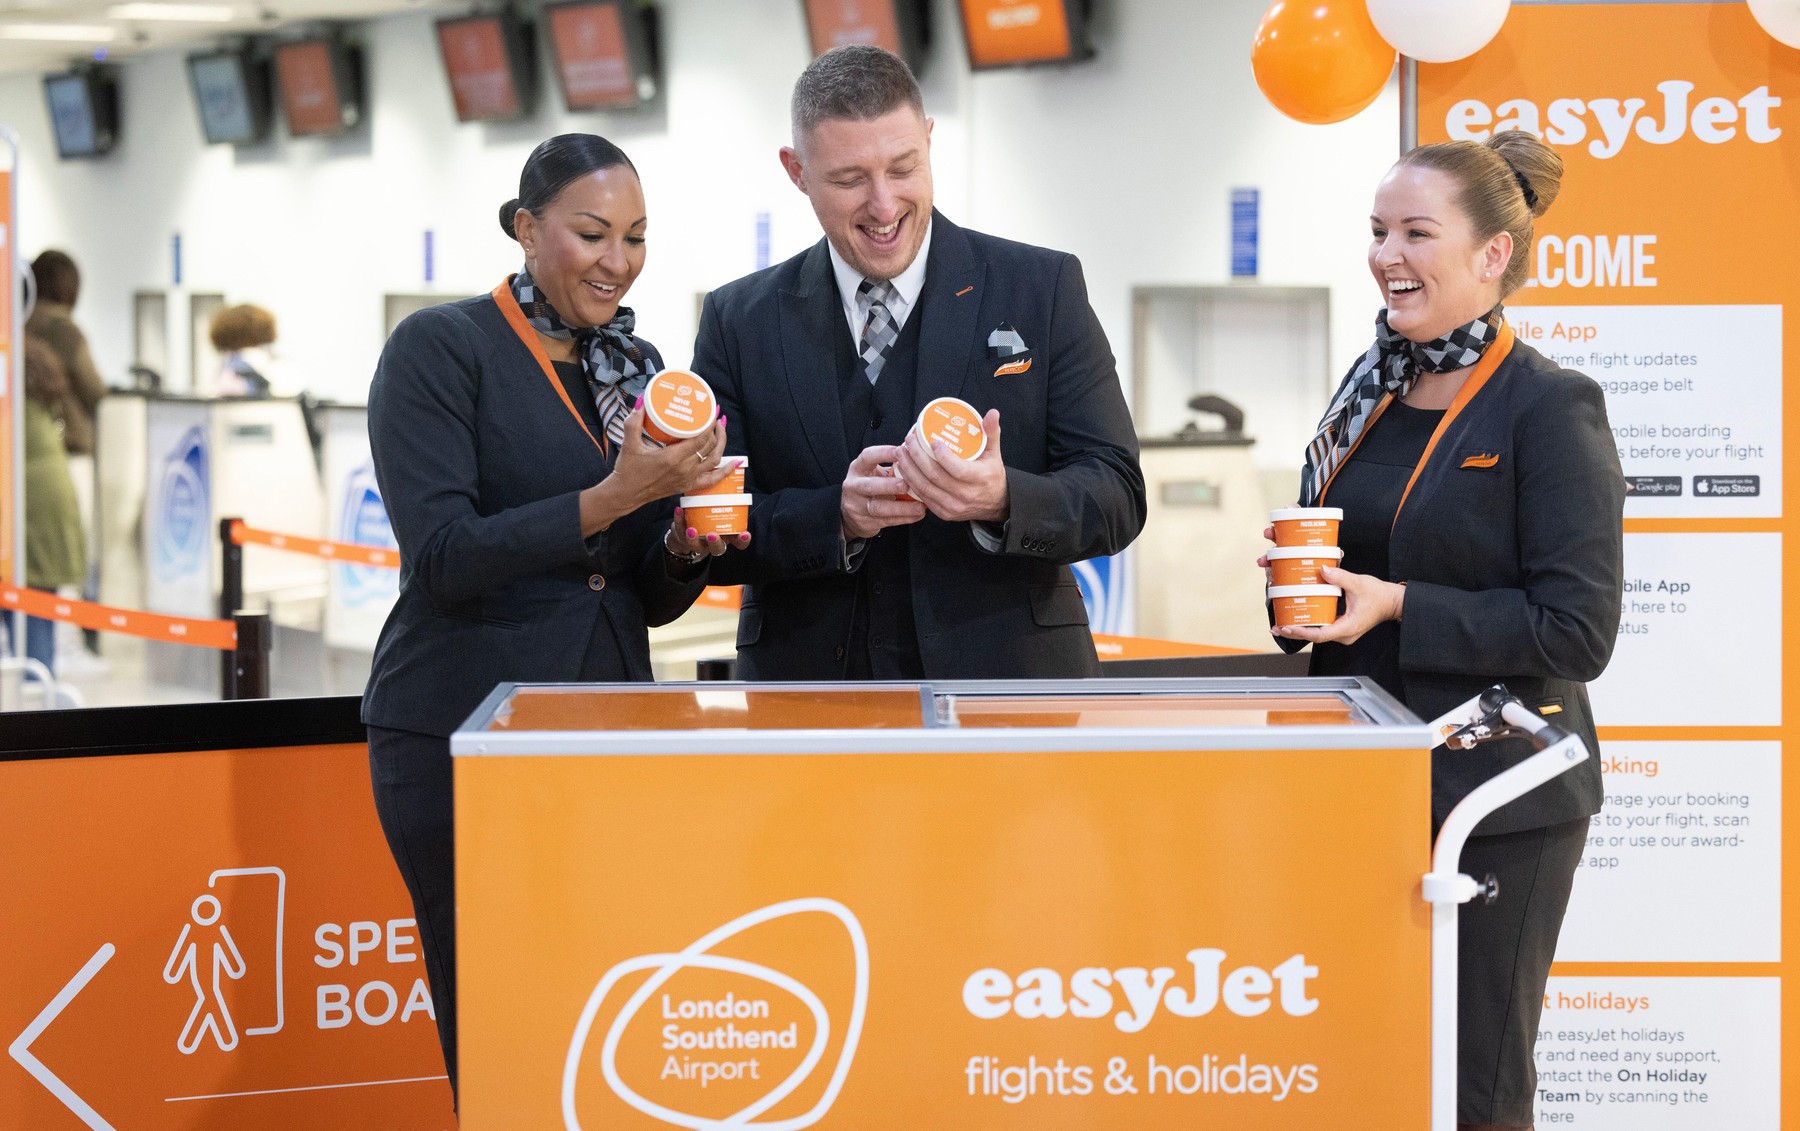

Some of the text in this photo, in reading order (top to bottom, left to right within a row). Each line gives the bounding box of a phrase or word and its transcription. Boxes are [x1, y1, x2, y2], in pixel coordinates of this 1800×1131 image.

[1445, 80, 1782, 159] easyJet
[1525, 235, 1657, 288] COME
[1551, 322, 1596, 342] App
[1590, 353, 1628, 368] flight
[1634, 352, 1697, 367] updates
[1601, 378, 1693, 394] aggage belt
[1662, 424, 1730, 440] boarding
[1630, 445, 1680, 458] before
[1686, 448, 1720, 461] your
[1725, 444, 1763, 460] flight
[1636, 483, 1680, 493] Google play
[1711, 484, 1756, 494] App Store
[1624, 579, 1690, 594] bile App
[1632, 600, 1665, 613] here
[1671, 601, 1686, 613] to
[1617, 622, 1649, 634] atus
[1600, 756, 1658, 777] oking
[1604, 793, 1749, 808] nage your booking
[1606, 814, 1621, 826] to
[1627, 816, 1661, 829] your
[1666, 813, 1707, 829] flight,
[1714, 816, 1749, 826] scan
[1609, 837, 1624, 847] or
[1630, 837, 1656, 847] use
[1661, 837, 1686, 847] our
[1691, 834, 1744, 847] award-
[1589, 857, 1618, 868] app
[314, 918, 417, 968] SPE
[963, 948, 1319, 1033] easyJet
[317, 978, 436, 1029] BOA
[662, 992, 769, 1019] London
[1558, 992, 1649, 1013] holidays
[663, 1023, 797, 1049] Southend
[1558, 1029, 1616, 1044] easyJet
[1622, 1028, 1684, 1044] holidays
[1546, 1049, 1574, 1061] and
[1581, 1049, 1618, 1061] need
[1624, 1052, 1651, 1064] any
[1656, 1050, 1720, 1064] support,
[661, 1056, 759, 1087] Airport
[965, 1054, 1318, 1103] flights & holidays
[1537, 1069, 1707, 1084] ontact the On Holiday
[1538, 1090, 1708, 1105] Team by scanning the
[1541, 1110, 1574, 1123] here
